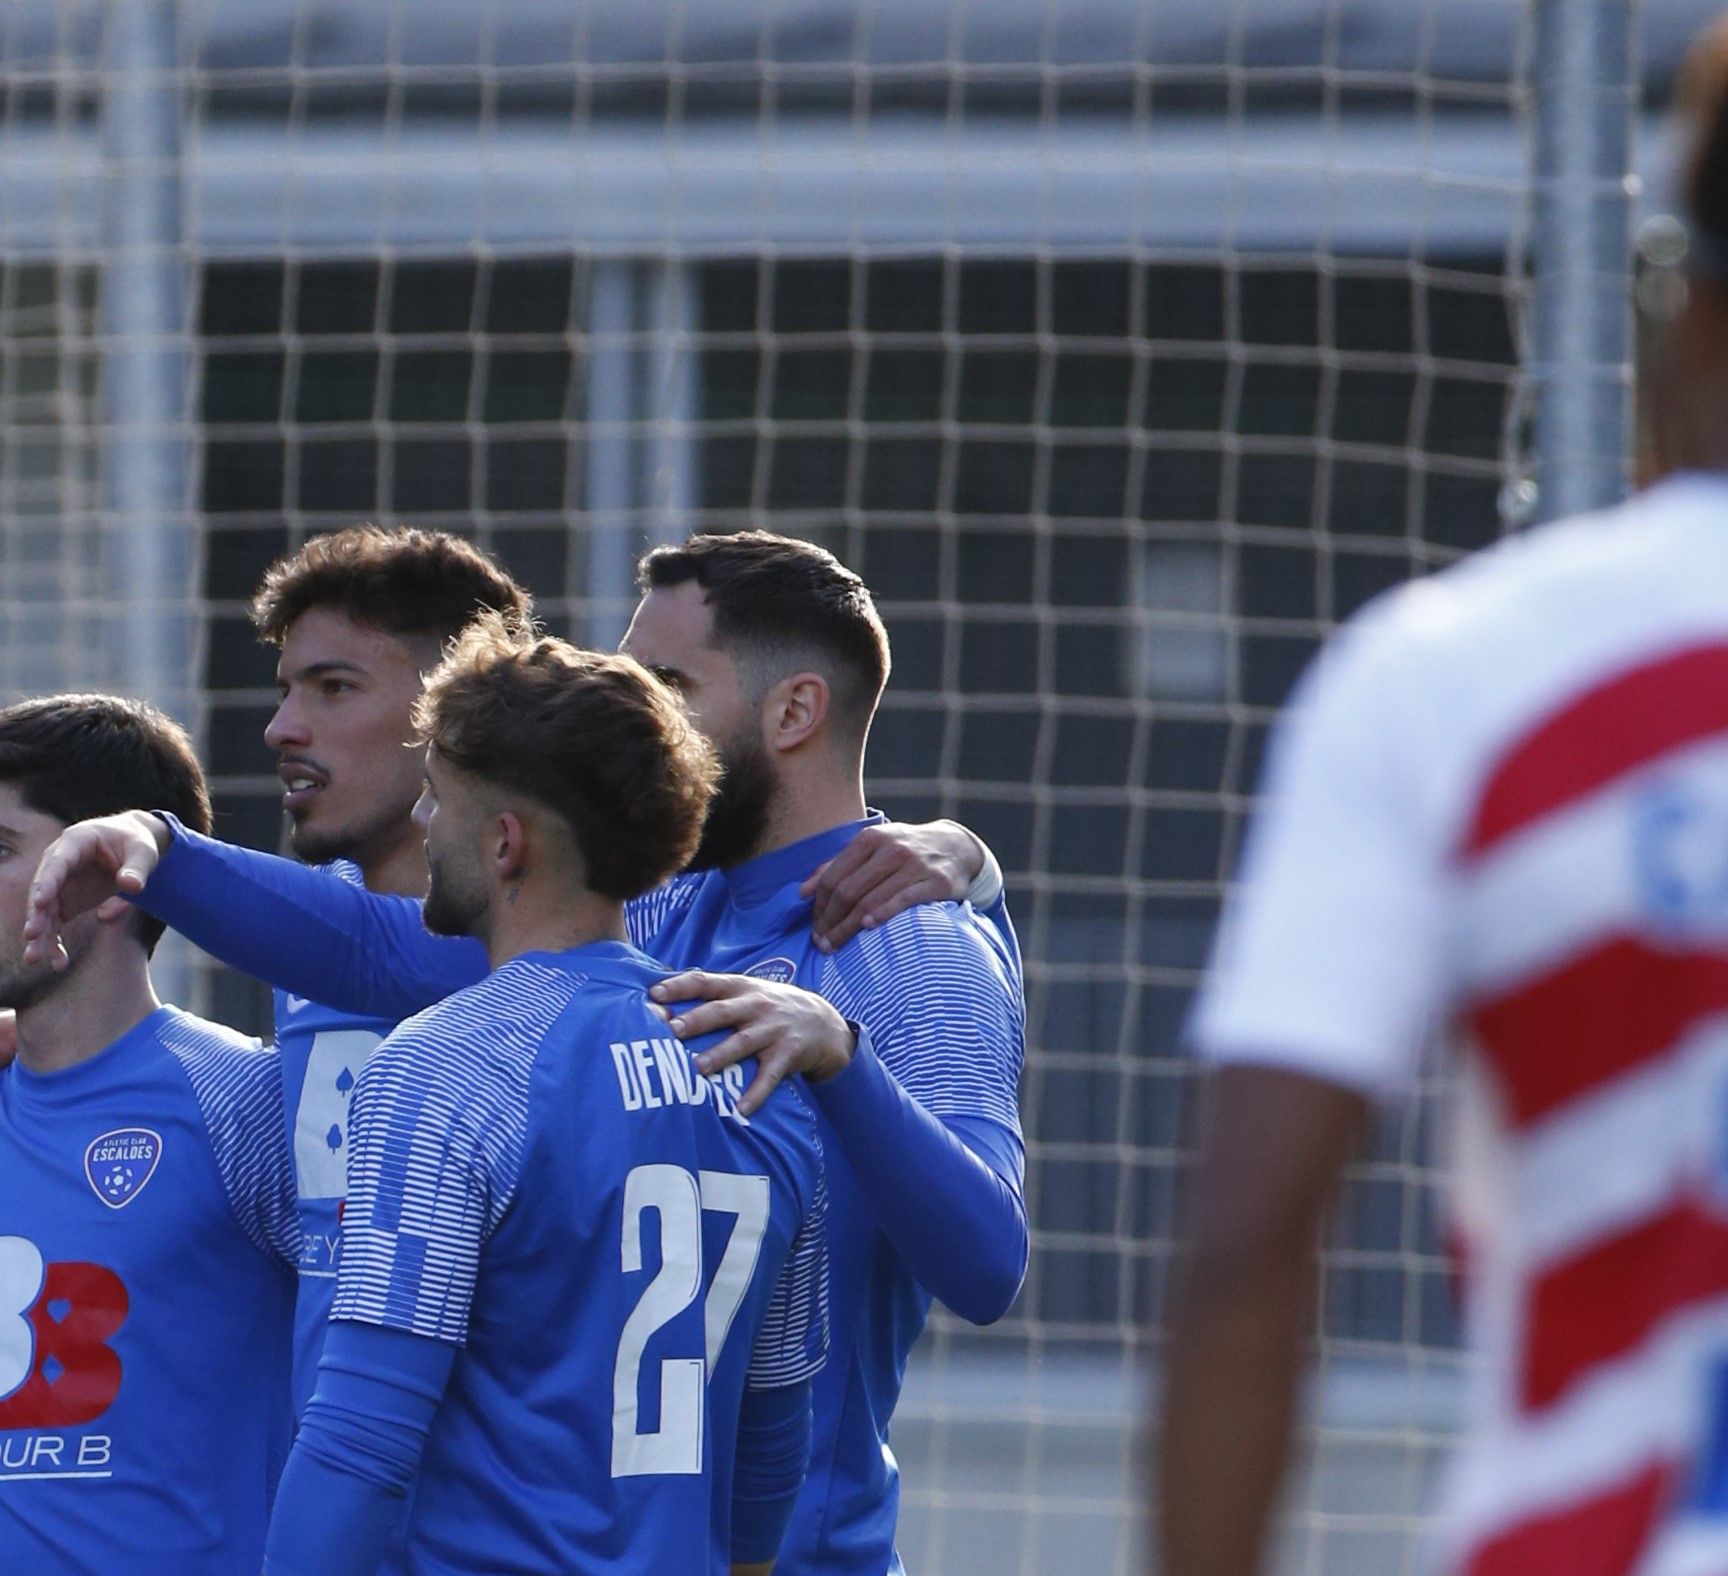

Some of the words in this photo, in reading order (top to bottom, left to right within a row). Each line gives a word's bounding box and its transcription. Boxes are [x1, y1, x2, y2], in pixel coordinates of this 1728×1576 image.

[93, 1145, 153, 1162] ESCALDES
[611, 1163, 771, 1478] 27
[77, 1435, 112, 1465] B
